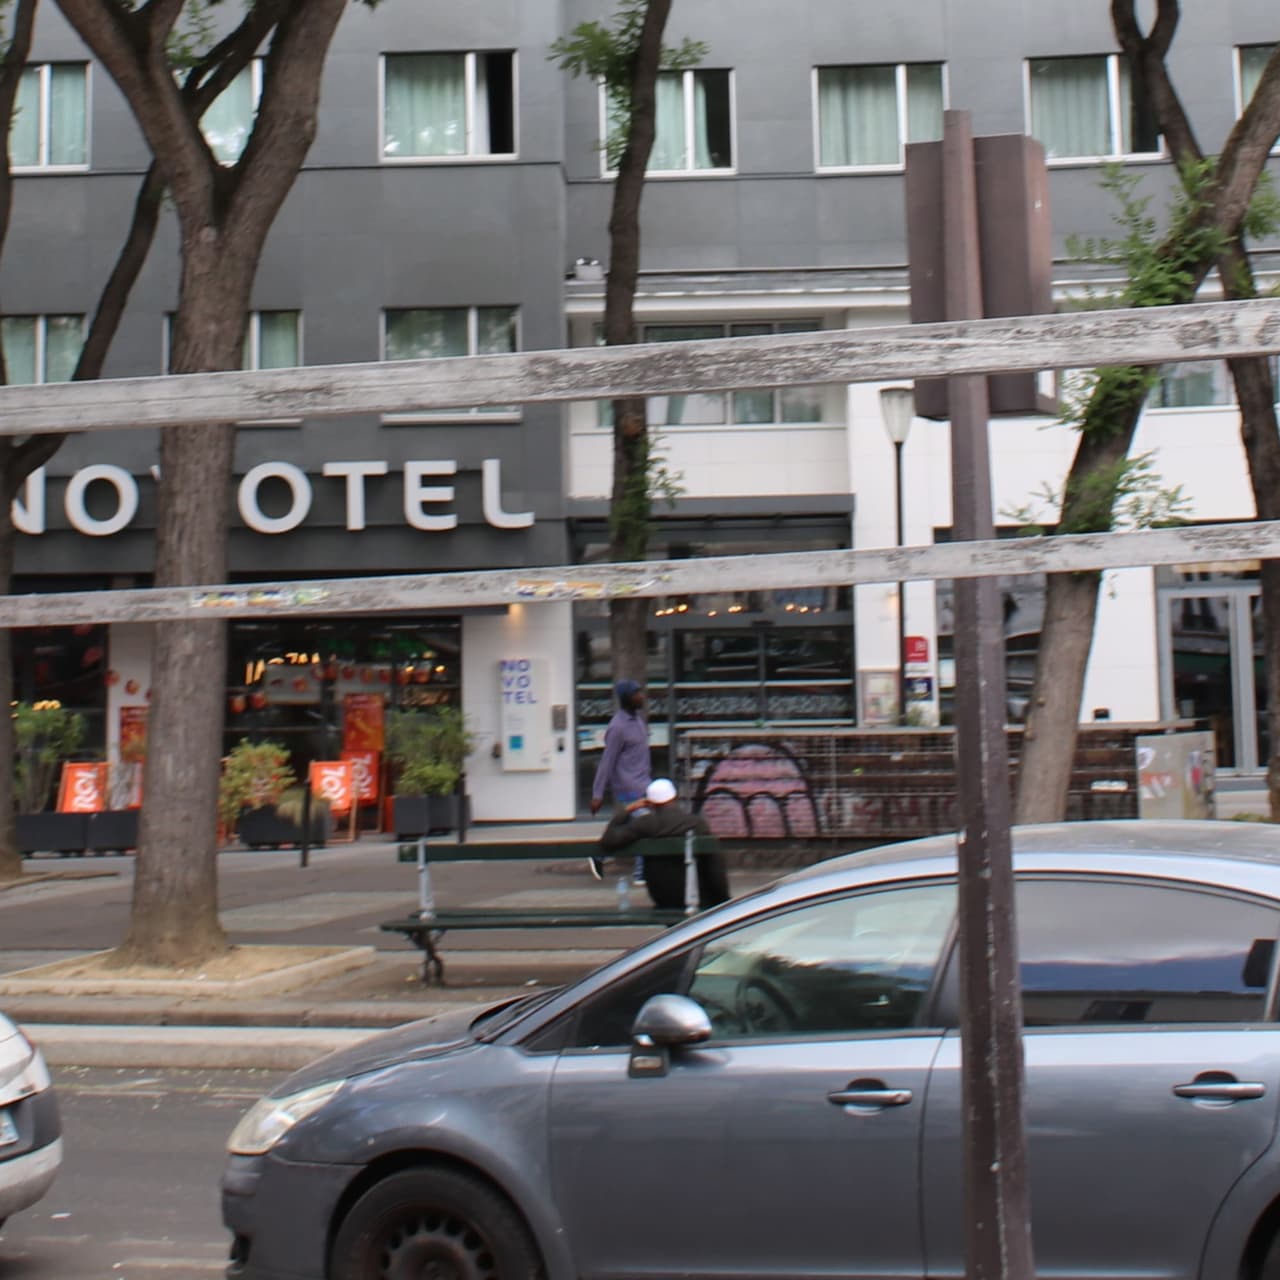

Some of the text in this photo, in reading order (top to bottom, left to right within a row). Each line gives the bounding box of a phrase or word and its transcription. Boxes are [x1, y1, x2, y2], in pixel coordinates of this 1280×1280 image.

[11, 459, 535, 536] NOOTEL
[499, 659, 530, 672] NO
[502, 675, 530, 689] VO
[502, 690, 537, 705] TEL
